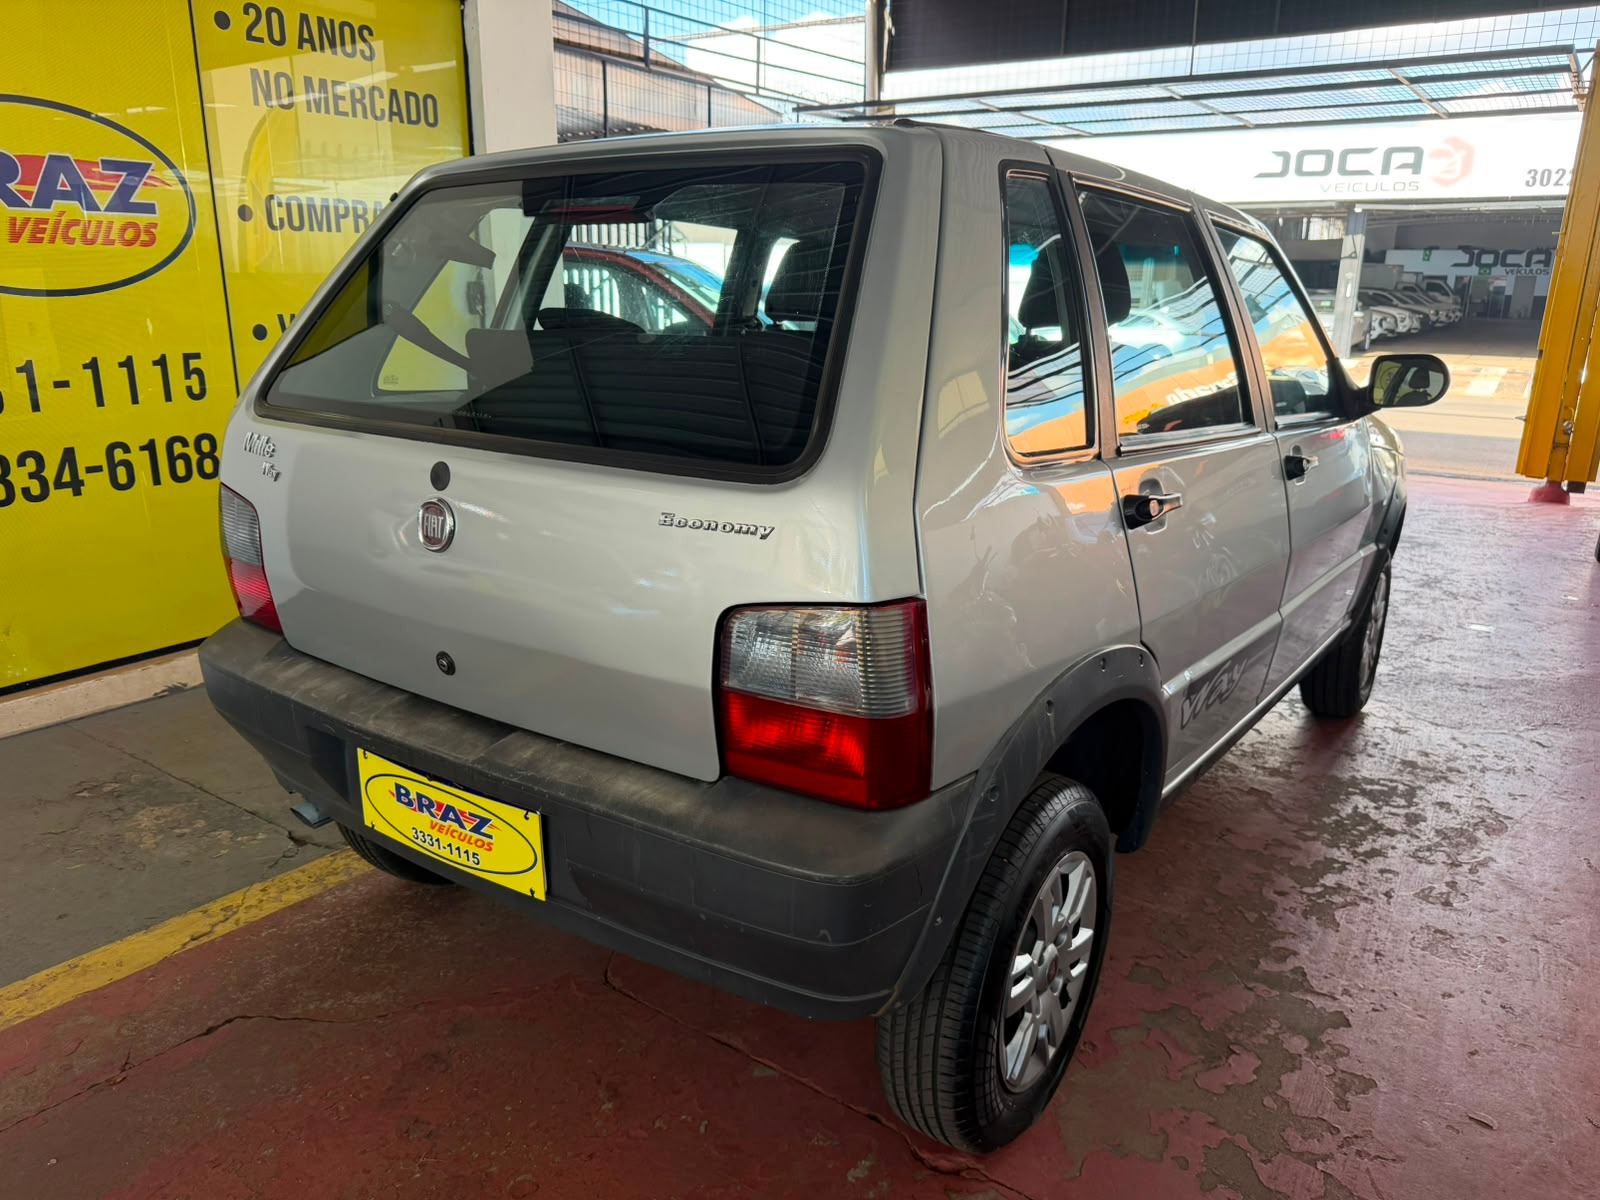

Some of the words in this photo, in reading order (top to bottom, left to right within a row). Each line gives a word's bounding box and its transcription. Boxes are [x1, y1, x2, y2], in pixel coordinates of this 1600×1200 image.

[242, 1, 287, 47] 20
[297, 11, 376, 62] ANOS
[249, 67, 294, 111] NO
[302, 75, 439, 128] MERCADO
[1253, 146, 1425, 179] JOCA
[7, 210, 158, 248] VEÍCULOS
[1449, 245, 1553, 268] JOCA
[0, 352, 208, 413] 1-1115
[242, 431, 276, 458] Mille
[424, 513, 444, 538] FIAT
[658, 512, 775, 540] Economy
[395, 783, 493, 840] BRAZ
[411, 827, 480, 866] 3331-1115
[429, 820, 493, 852] VEÍCULOS
